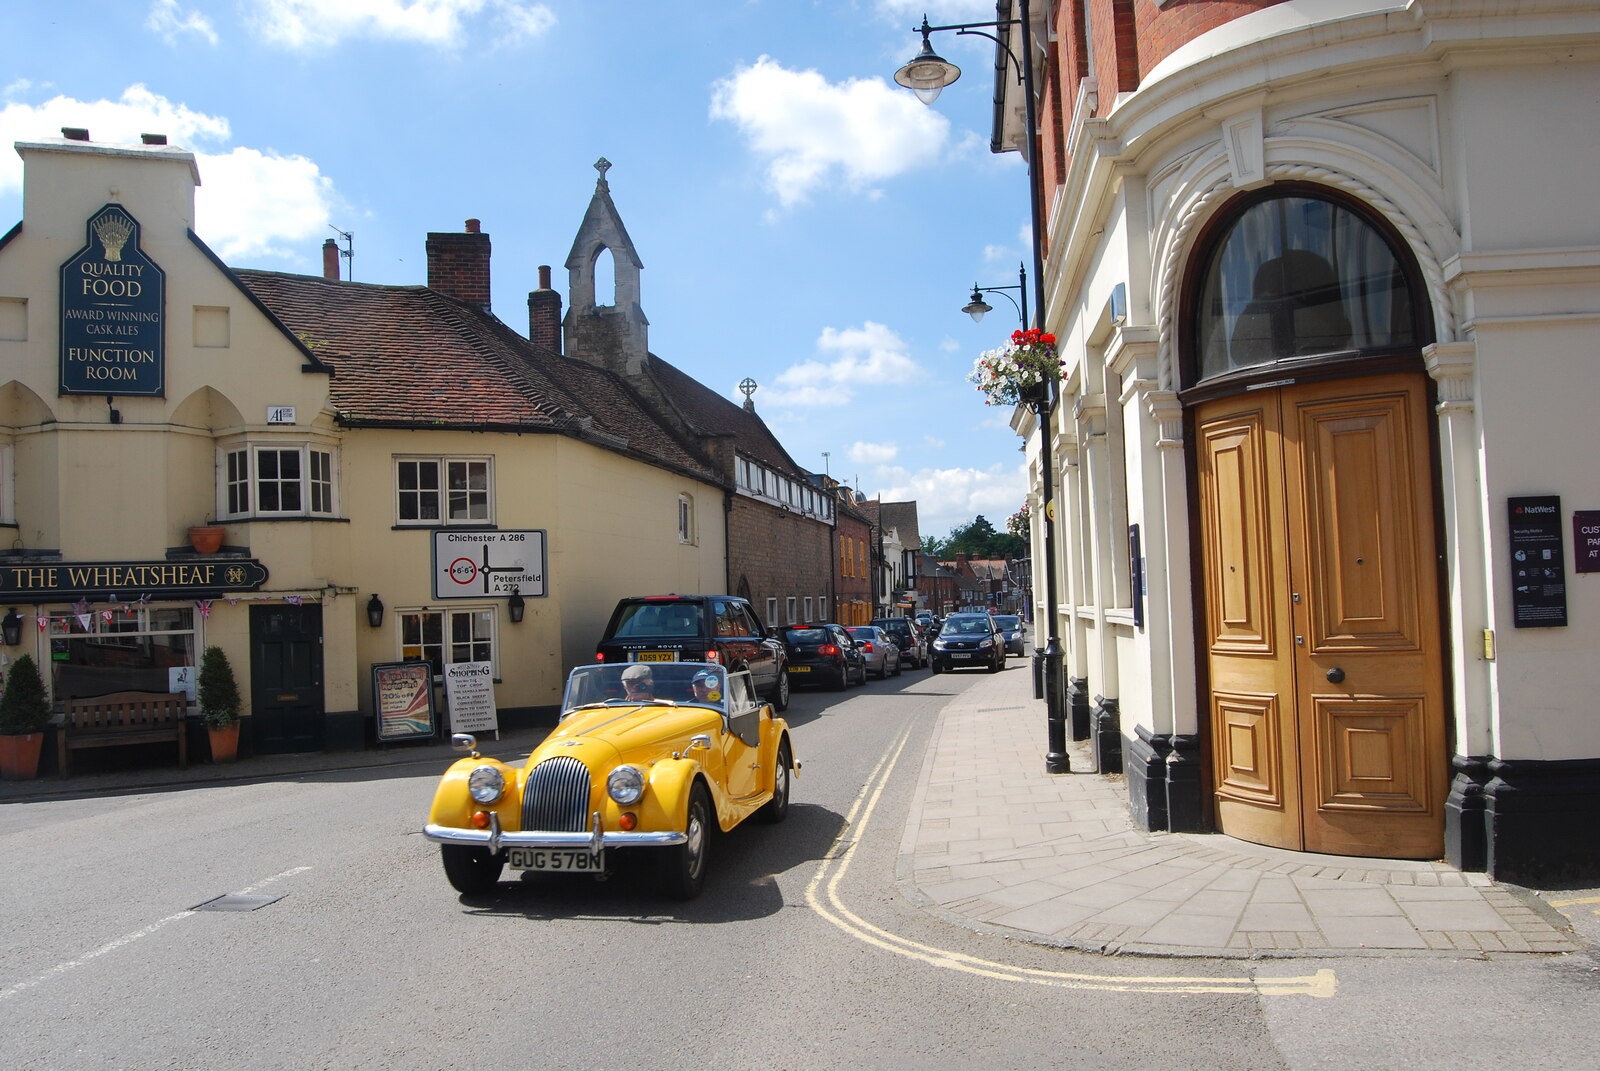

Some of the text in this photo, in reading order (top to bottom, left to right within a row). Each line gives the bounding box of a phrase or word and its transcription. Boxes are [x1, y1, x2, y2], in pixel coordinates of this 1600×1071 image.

[81, 262, 144, 277] QUALITY
[83, 279, 141, 297] FOOD
[66, 310, 159, 322] AWARD WINNING
[86, 324, 139, 336] CASK ALES
[69, 348, 154, 363] FUNCTION
[86, 366, 137, 380] ROOM
[270, 409, 283, 421] A1
[11, 565, 215, 588] THE WHEATSHEAF
[512, 851, 602, 870] GUG 578N
